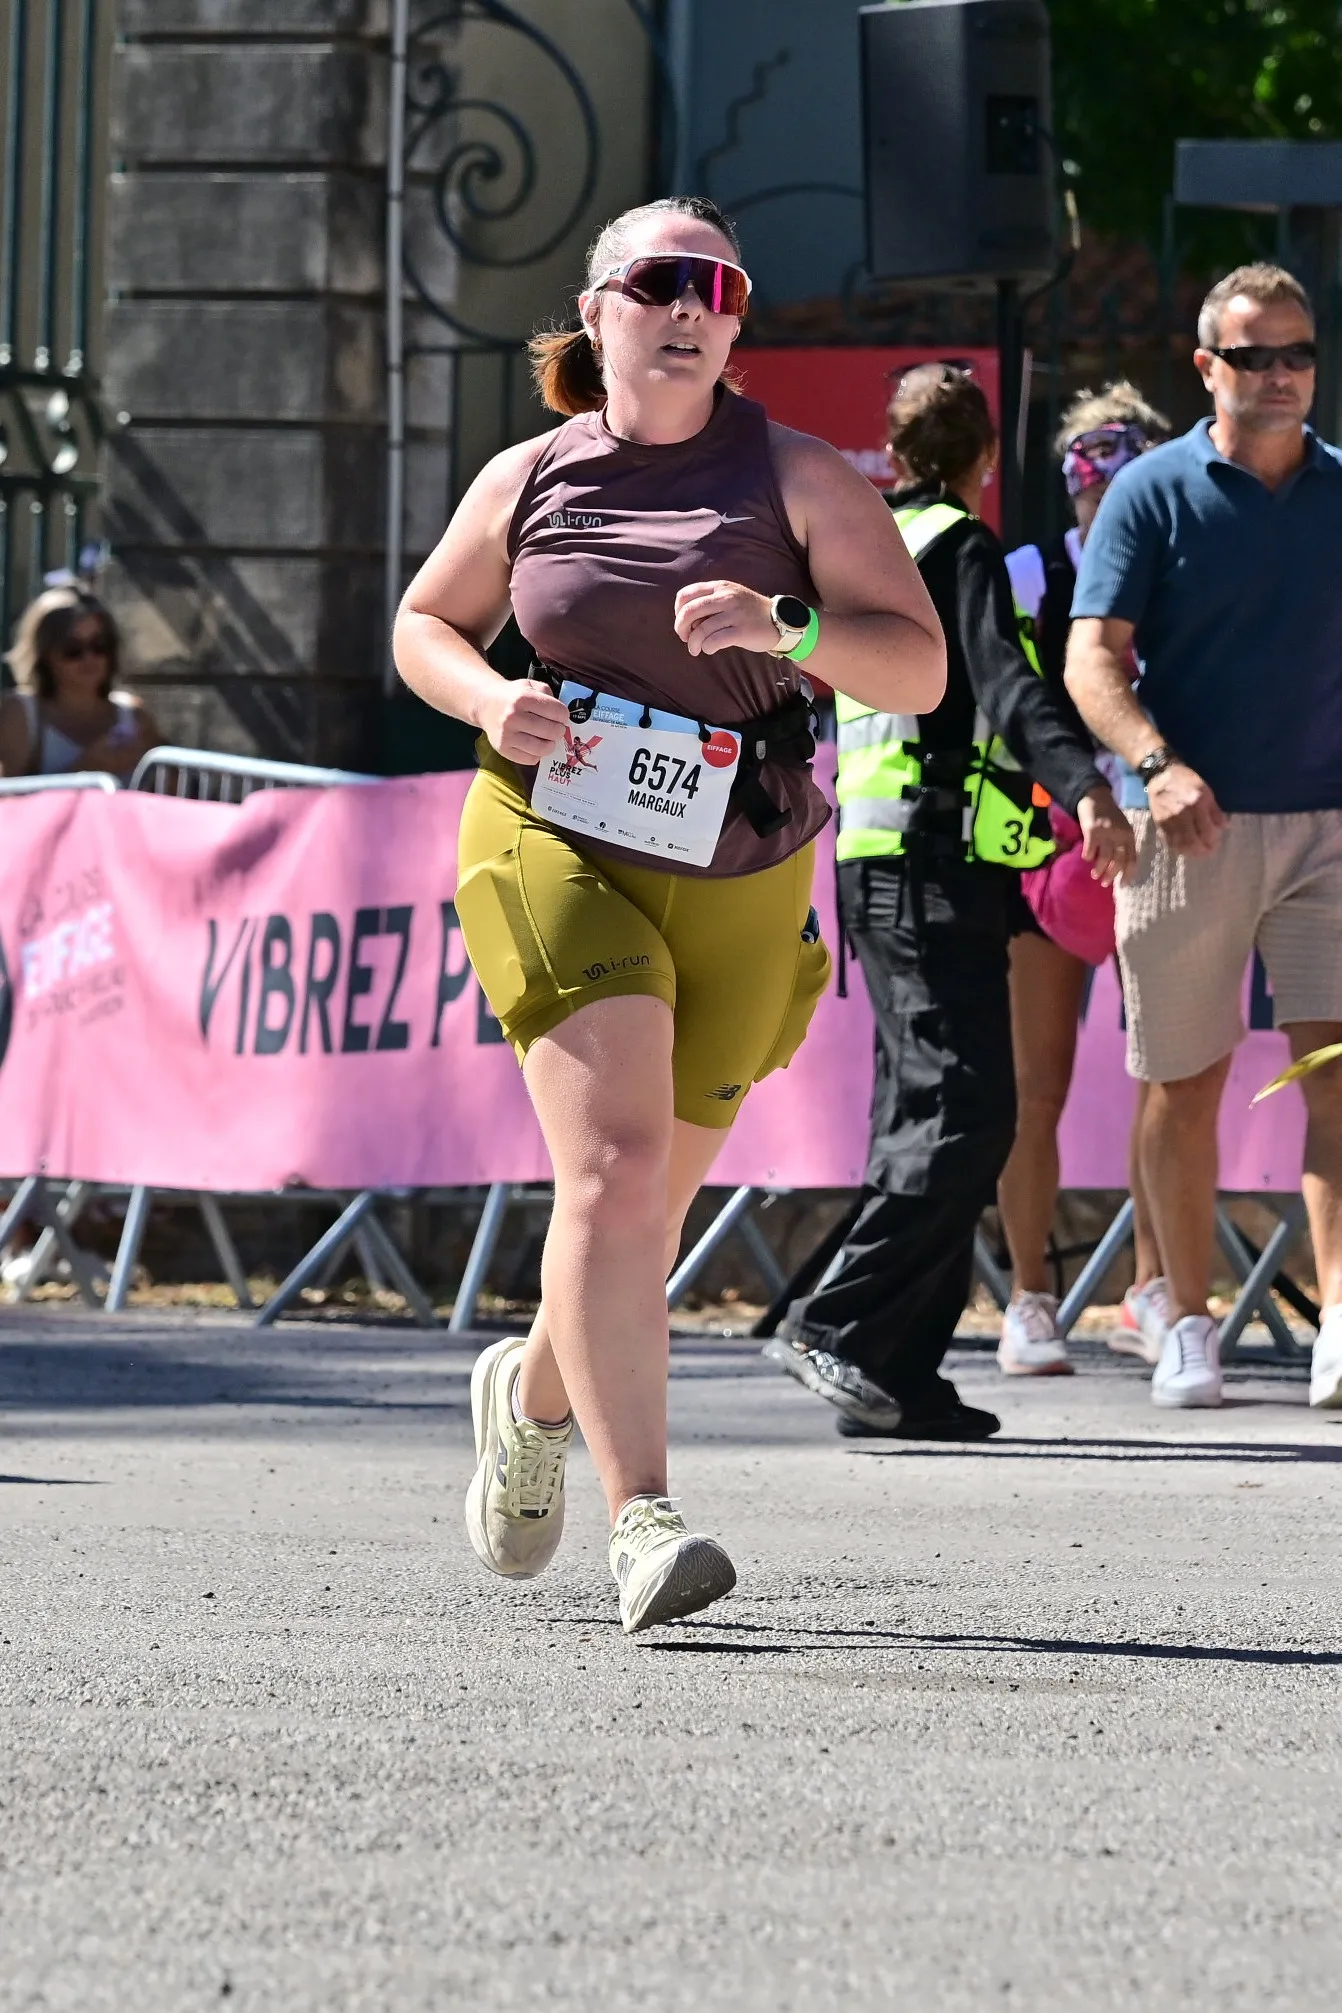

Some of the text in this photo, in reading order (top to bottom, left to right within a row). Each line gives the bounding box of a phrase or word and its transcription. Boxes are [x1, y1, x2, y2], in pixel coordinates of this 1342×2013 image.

[567, 511, 602, 527] i-run
[592, 709, 625, 721] EIFFAGE
[706, 744, 733, 754] EIFFAGE
[549, 766, 572, 779] PLUS
[552, 759, 582, 776] VIBREZ
[628, 747, 702, 800] 6574
[547, 774, 572, 786] HAUT
[627, 789, 687, 819] MARGAUX
[1001, 820, 1028, 856] 3
[609, 954, 650, 971] i-run
[200, 905, 414, 1057] VIBREZ
